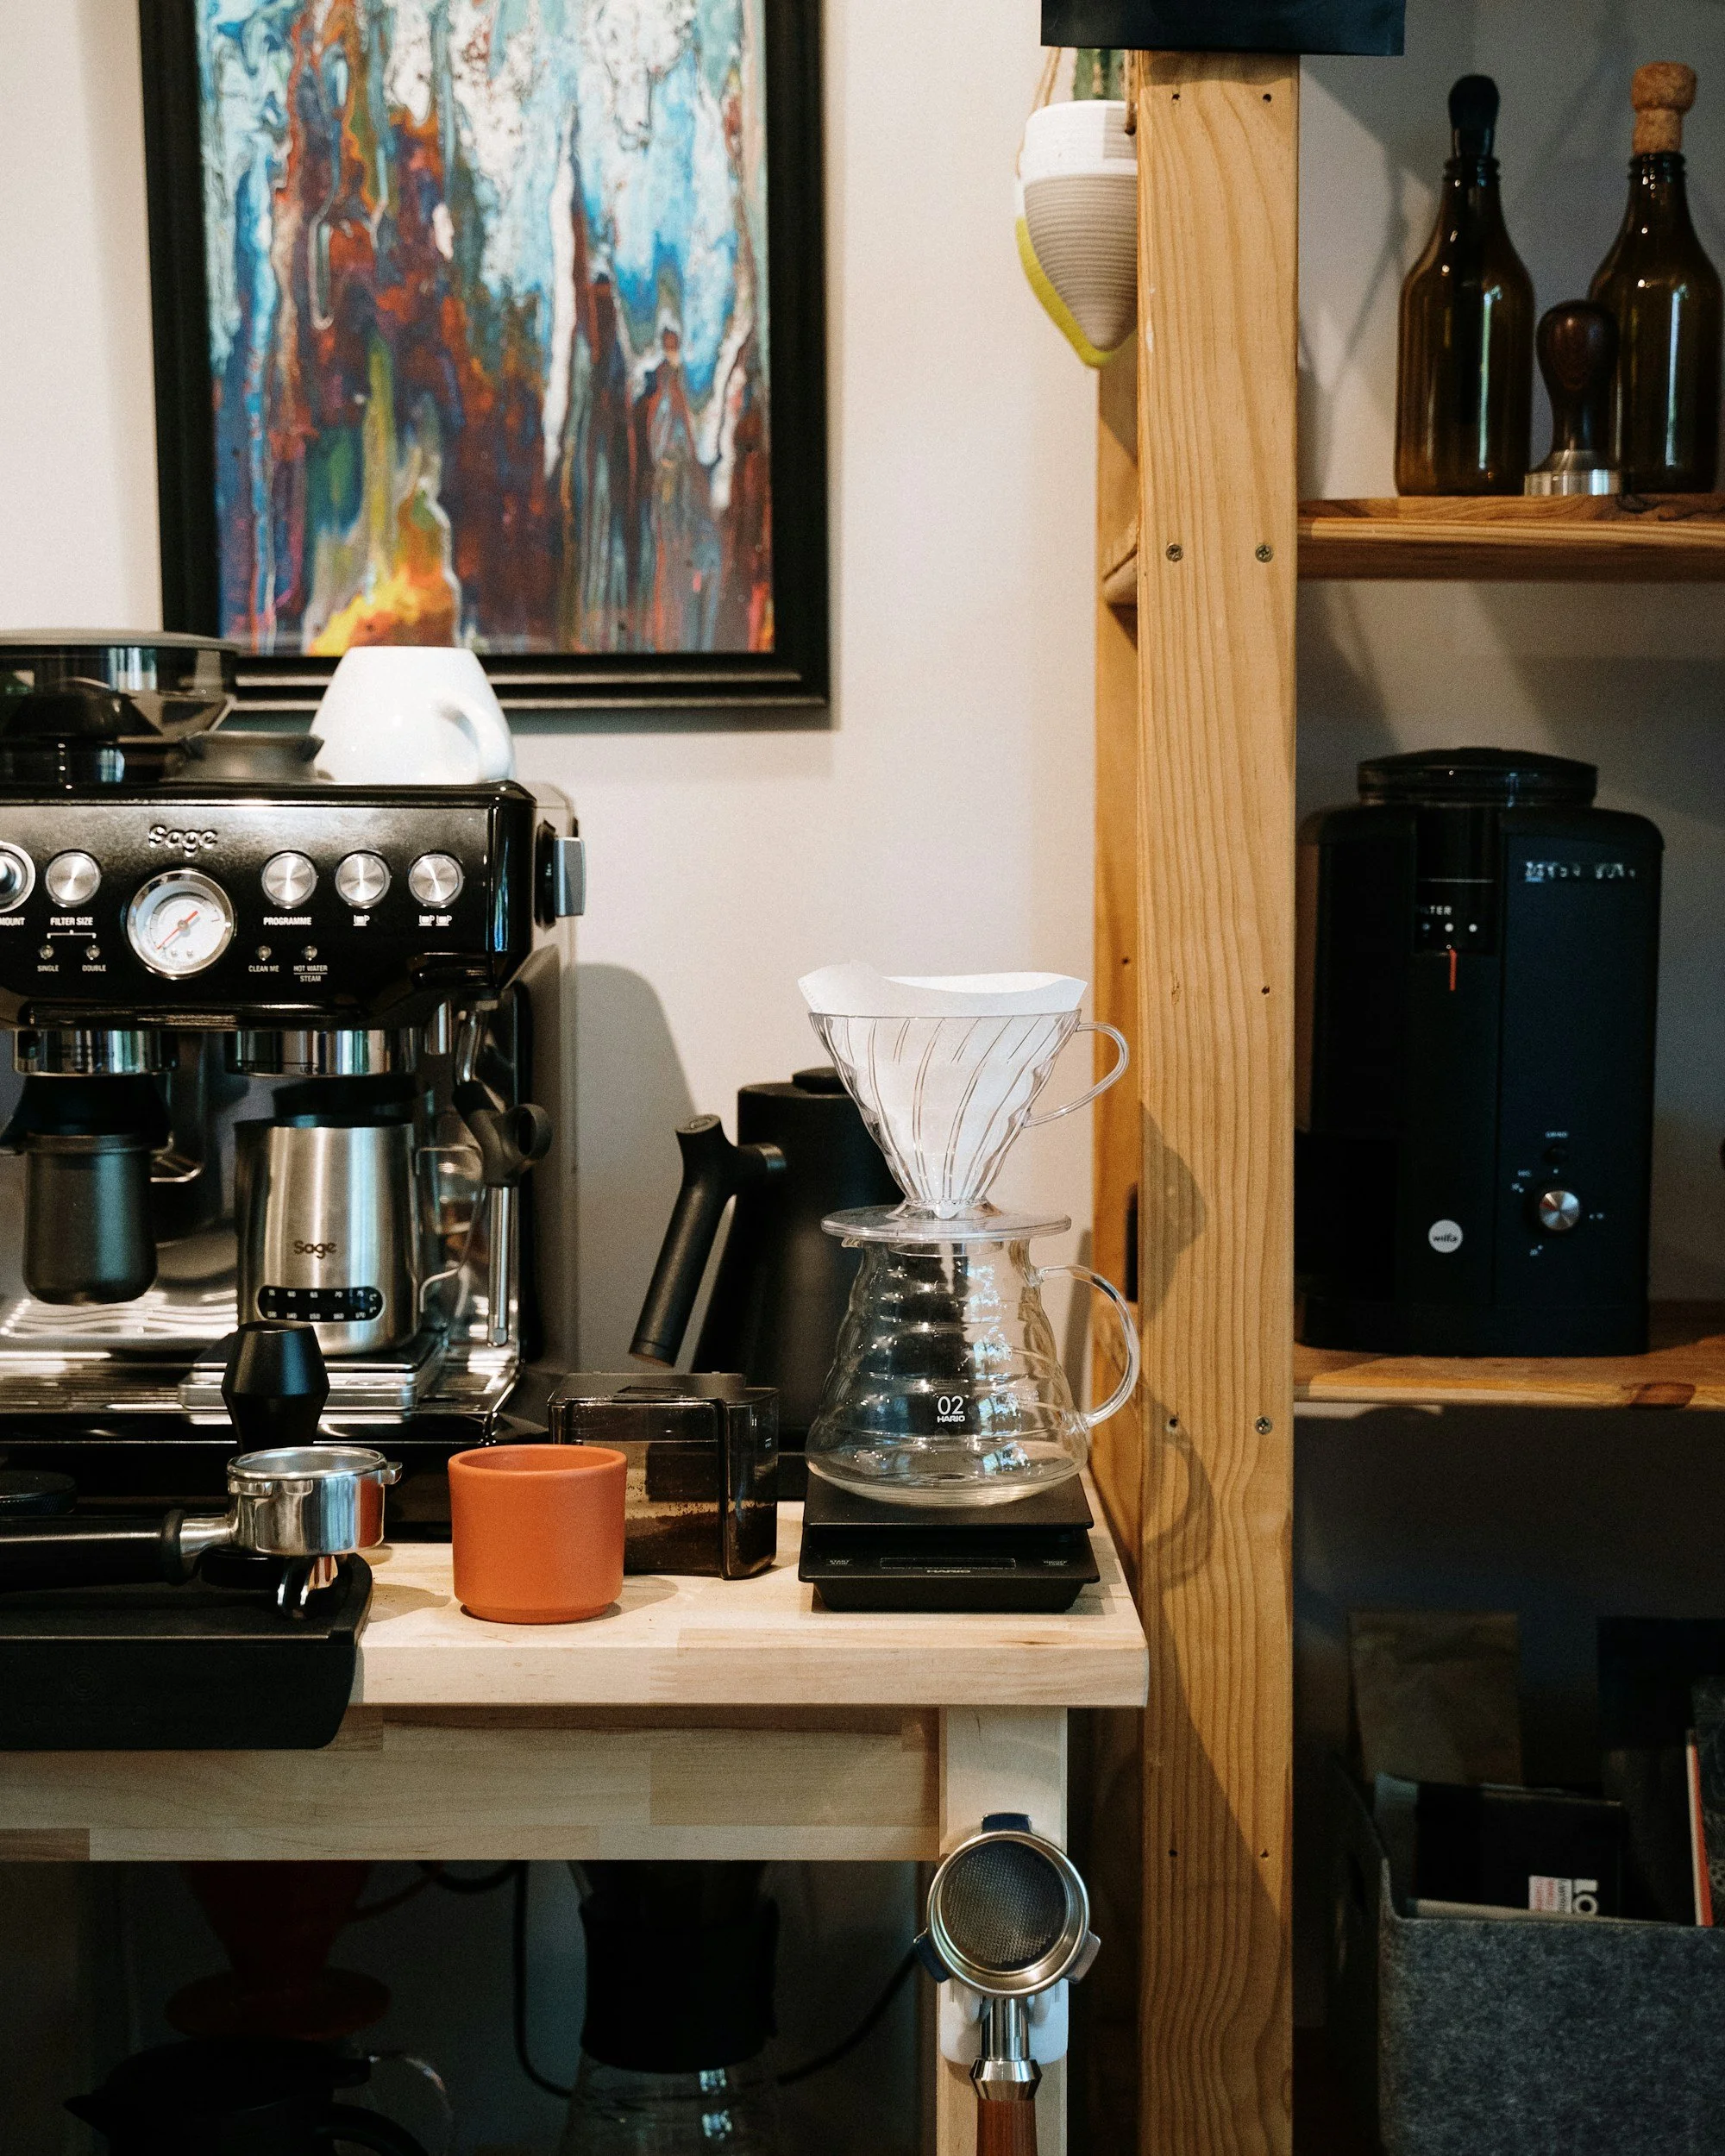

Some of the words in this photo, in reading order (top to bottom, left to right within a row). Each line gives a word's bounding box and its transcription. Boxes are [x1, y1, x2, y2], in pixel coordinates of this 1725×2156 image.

[147, 824, 218, 858] Sage
[49, 917, 76, 926] FILTER
[76, 917, 94, 926] SIZE
[262, 916, 312, 926] PROGRAMME
[293, 1239, 337, 1259] Sage
[937, 1395, 964, 1416] 02
